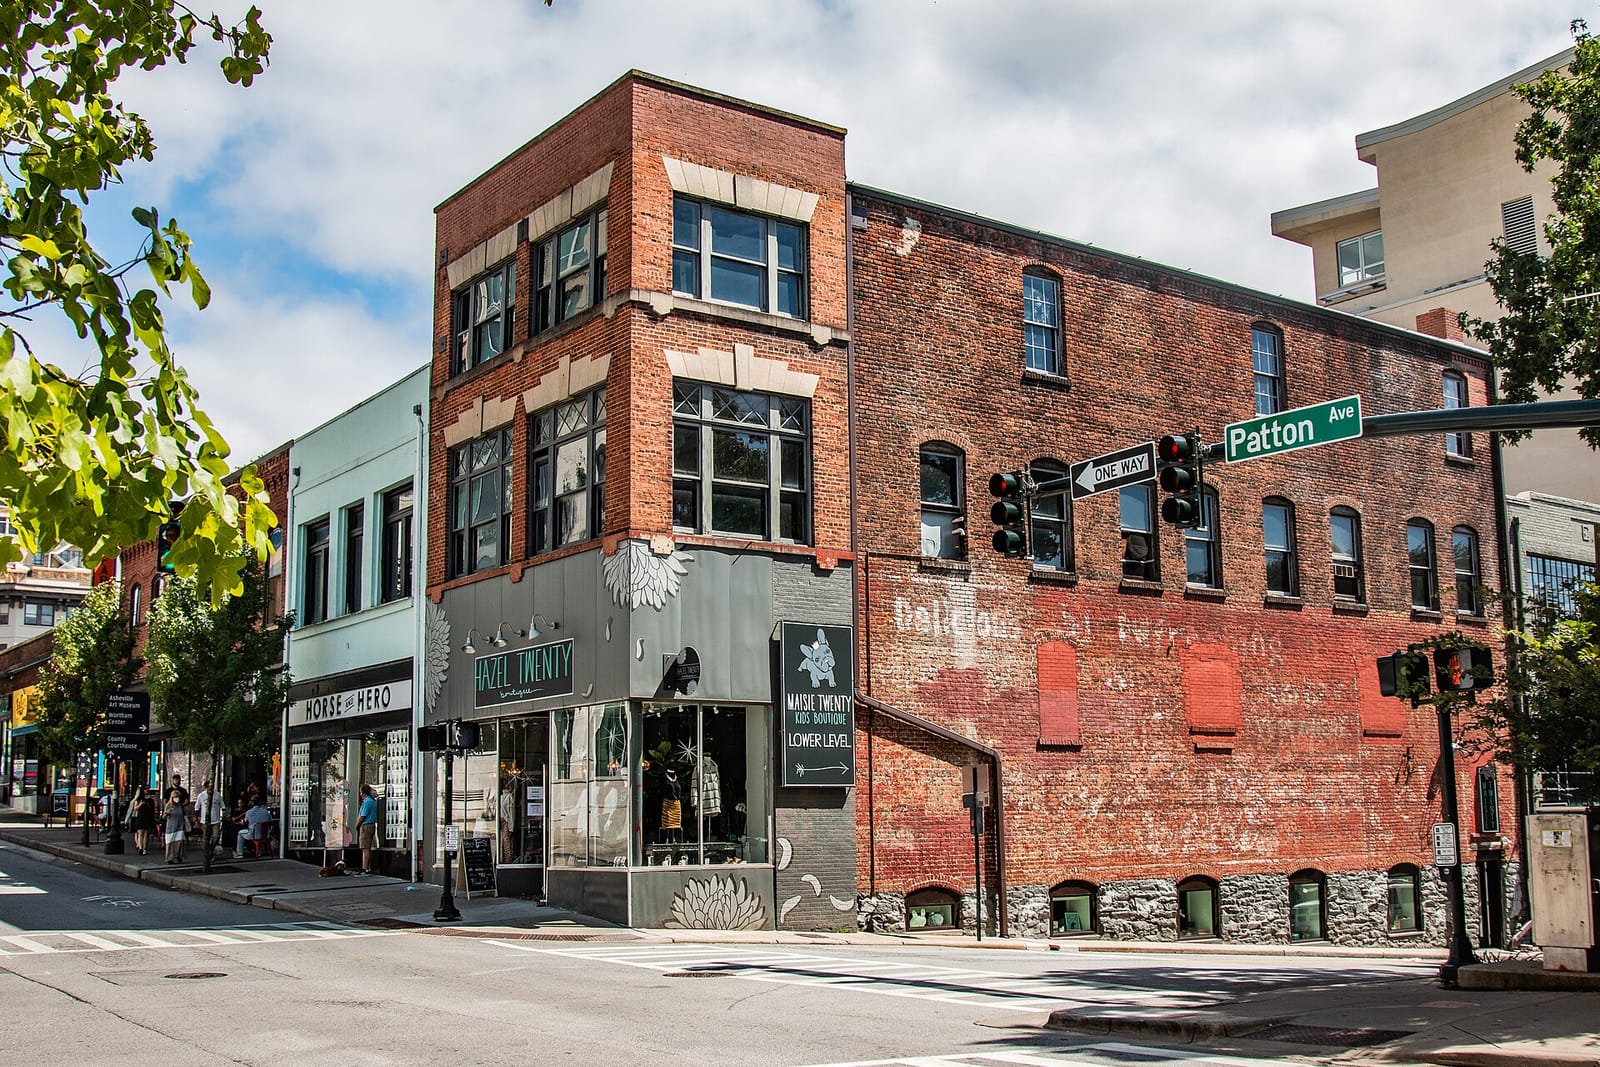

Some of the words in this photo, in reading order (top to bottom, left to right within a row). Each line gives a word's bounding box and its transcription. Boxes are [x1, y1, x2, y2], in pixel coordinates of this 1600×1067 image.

[1230, 419, 1314, 457] Patton
[1329, 405, 1354, 424] Ave
[1095, 462, 1118, 482] ONE
[1121, 456, 1145, 475] WAY
[475, 655, 512, 691] HAZEL
[517, 642, 572, 684] TWENTY
[306, 695, 342, 720] HORSE
[357, 686, 391, 713] HERO
[500, 687, 545, 699] boutique
[787, 693, 815, 711] MAISIE
[817, 694, 852, 713] TWENTY
[795, 711, 810, 725] KIDS
[813, 712, 847, 725] BOUTIQUE
[107, 735, 126, 743] County
[788, 732, 822, 748] LOWER
[823, 733, 852, 748] LEVEL
